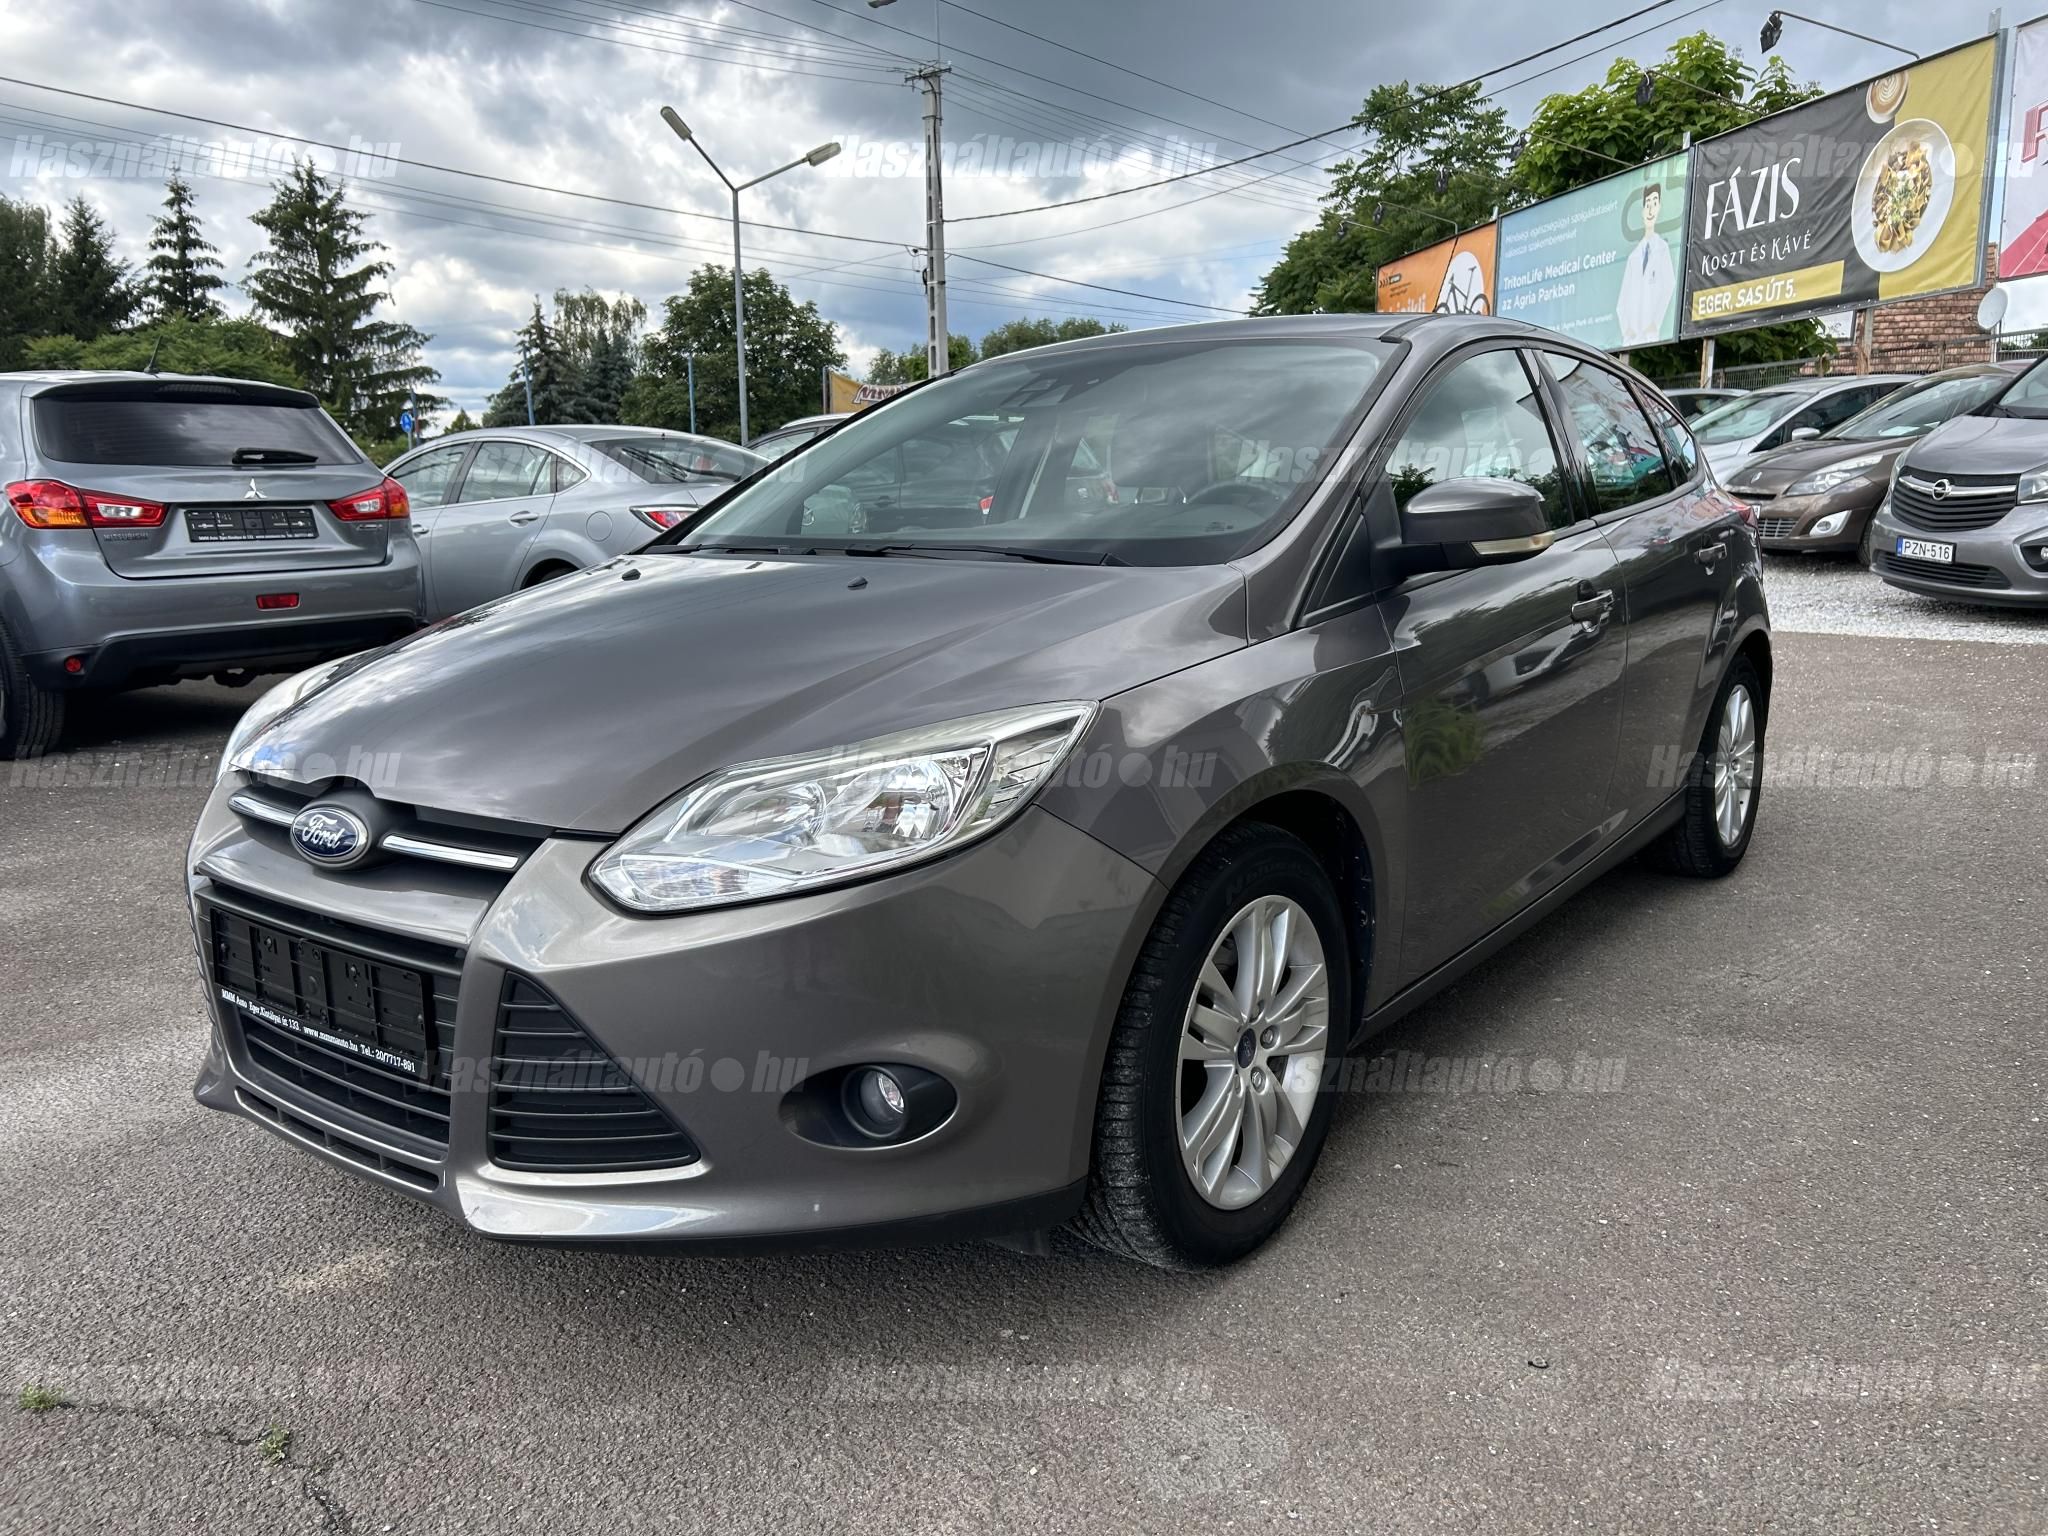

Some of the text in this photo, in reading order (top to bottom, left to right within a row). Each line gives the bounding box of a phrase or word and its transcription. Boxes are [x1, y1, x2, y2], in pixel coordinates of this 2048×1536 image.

[1704, 157, 1800, 240] FÁZIS
[1503, 250, 1617, 290] TritonLife Medical Center
[1502, 283, 1575, 311] az Agria Parkban
[1698, 277, 1797, 315] EGER, SAS ÚT 5.
[1904, 541, 1950, 560] PZN-516
[301, 814, 346, 849] Ford
